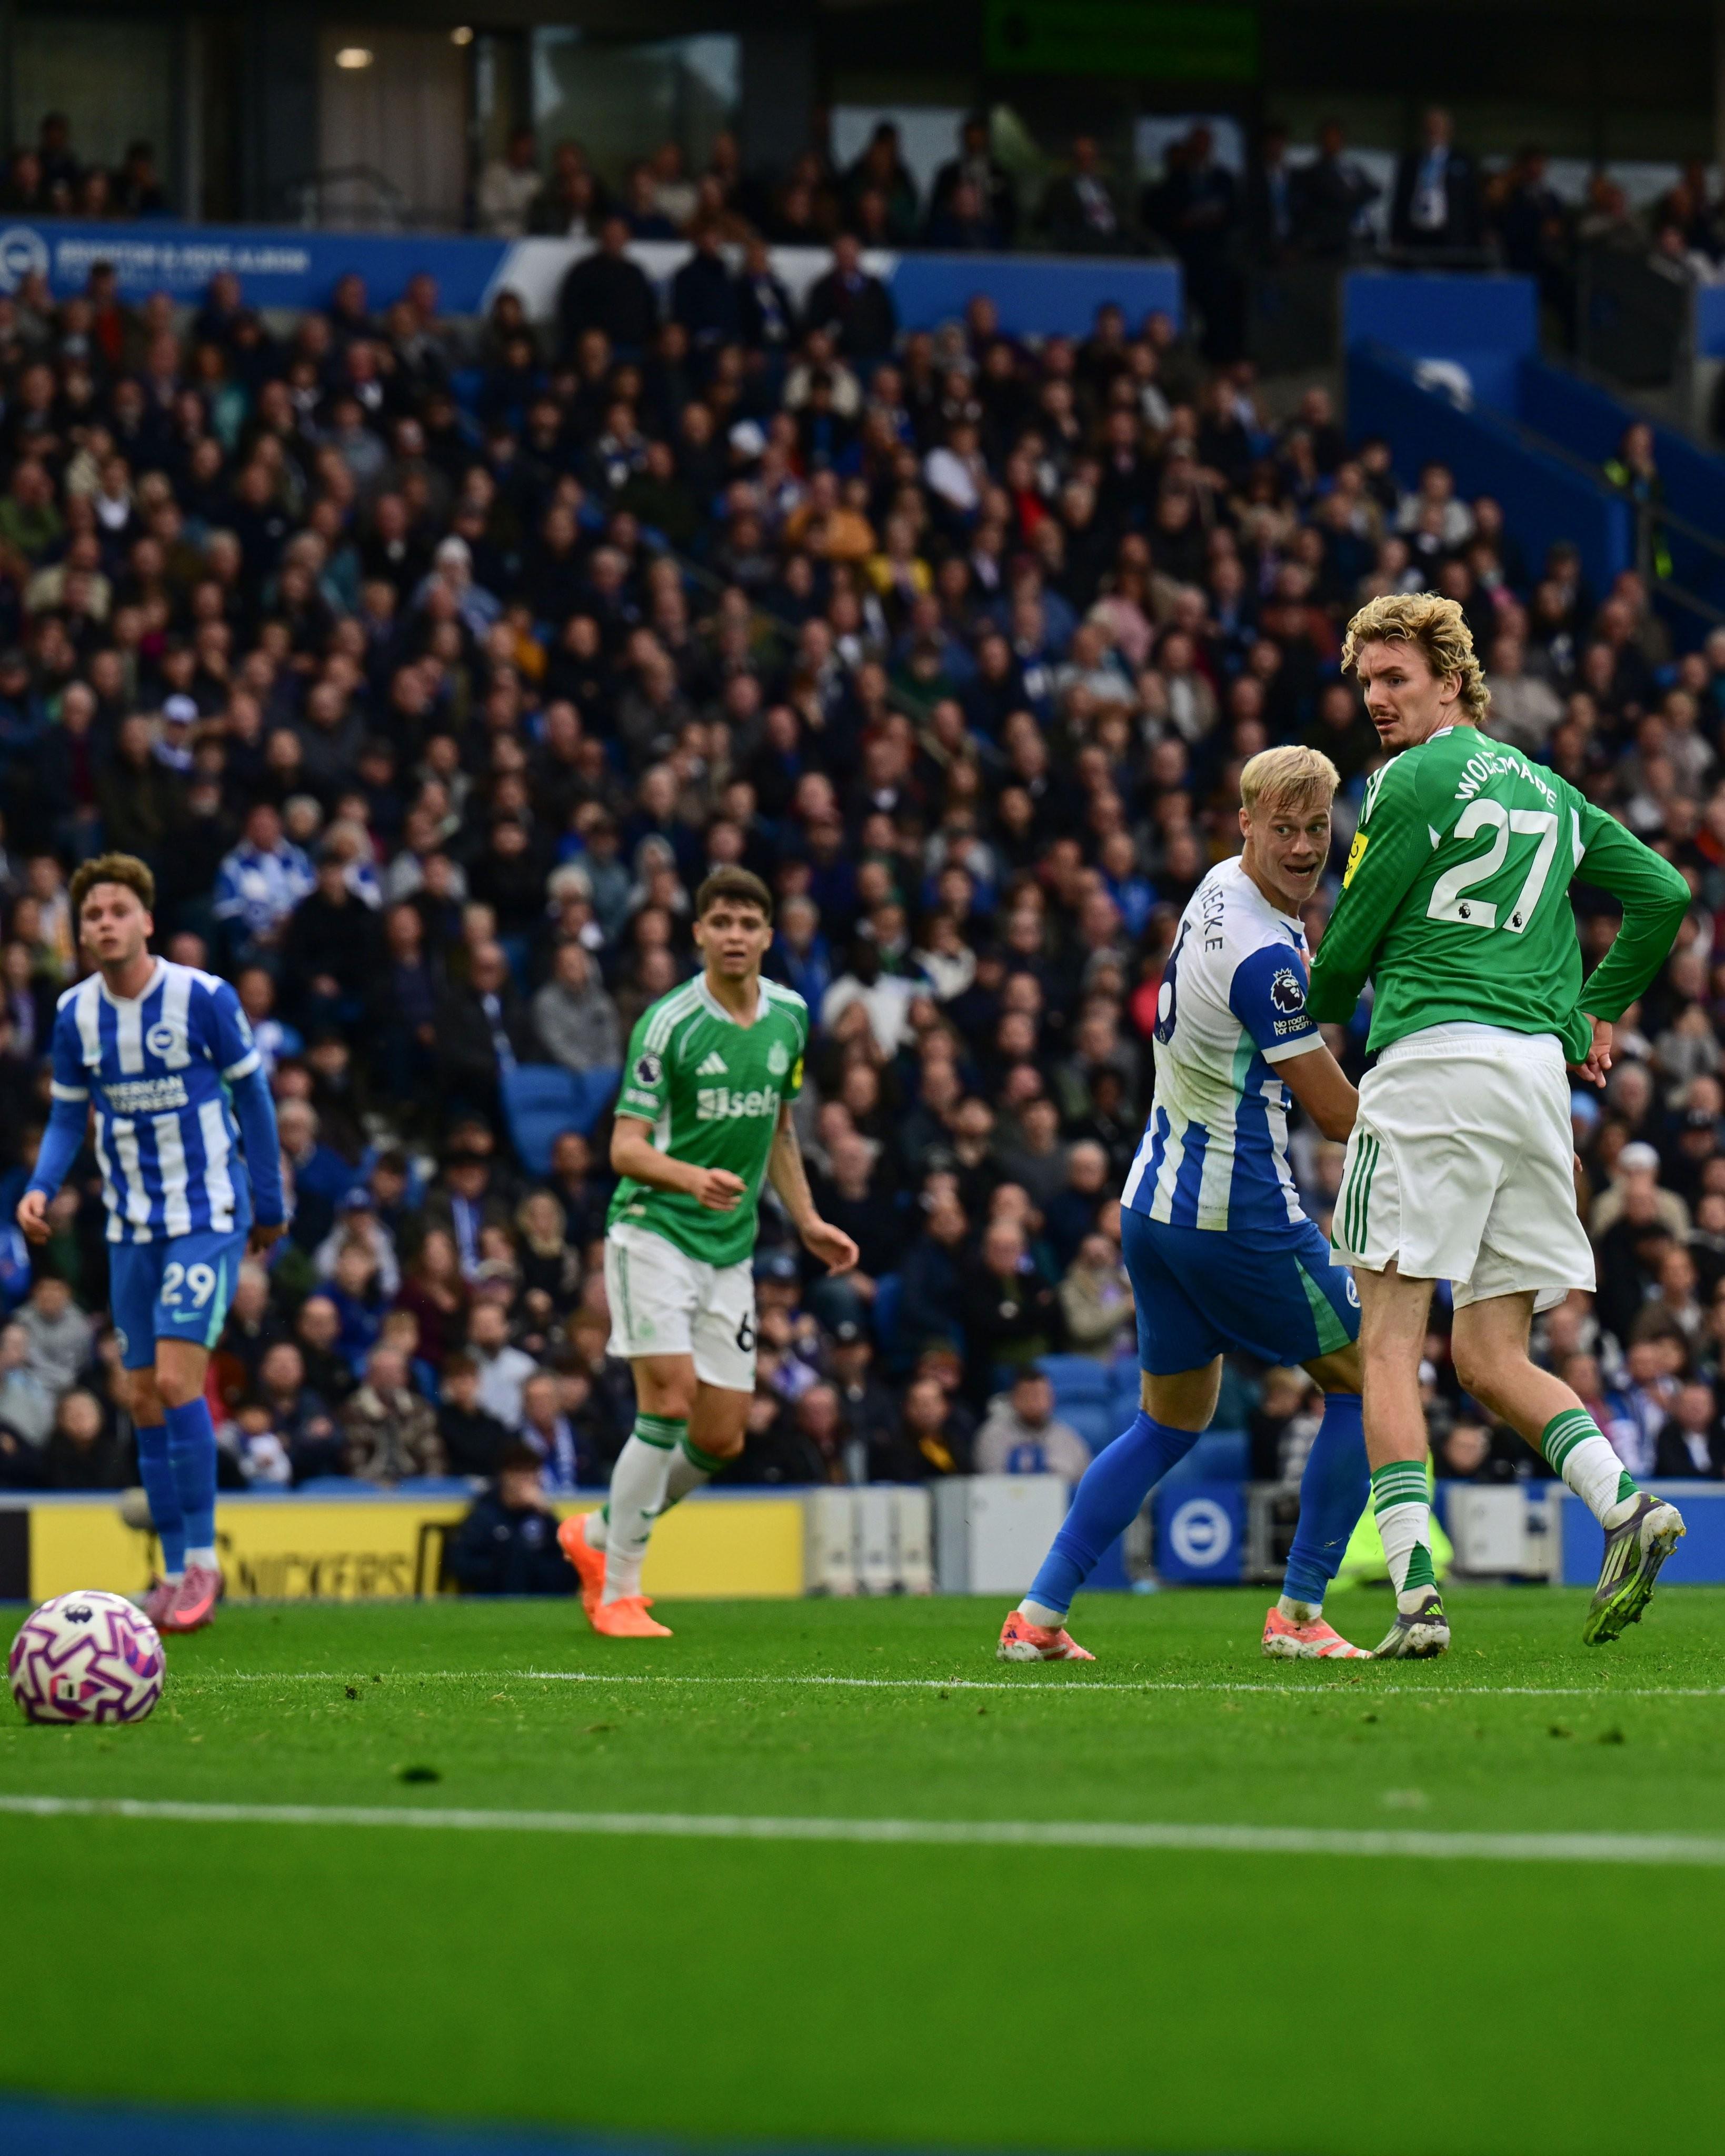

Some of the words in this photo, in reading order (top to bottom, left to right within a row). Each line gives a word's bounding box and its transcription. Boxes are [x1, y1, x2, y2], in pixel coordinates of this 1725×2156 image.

[1426, 798, 1558, 934] 27
[1273, 1020, 1287, 1028] No
[1288, 1015, 1308, 1026] room
[1274, 1027, 1288, 1036] for
[1288, 1020, 1312, 1033] racism
[161, 1262, 216, 1309] 29
[736, 1312, 757, 1352] 6
